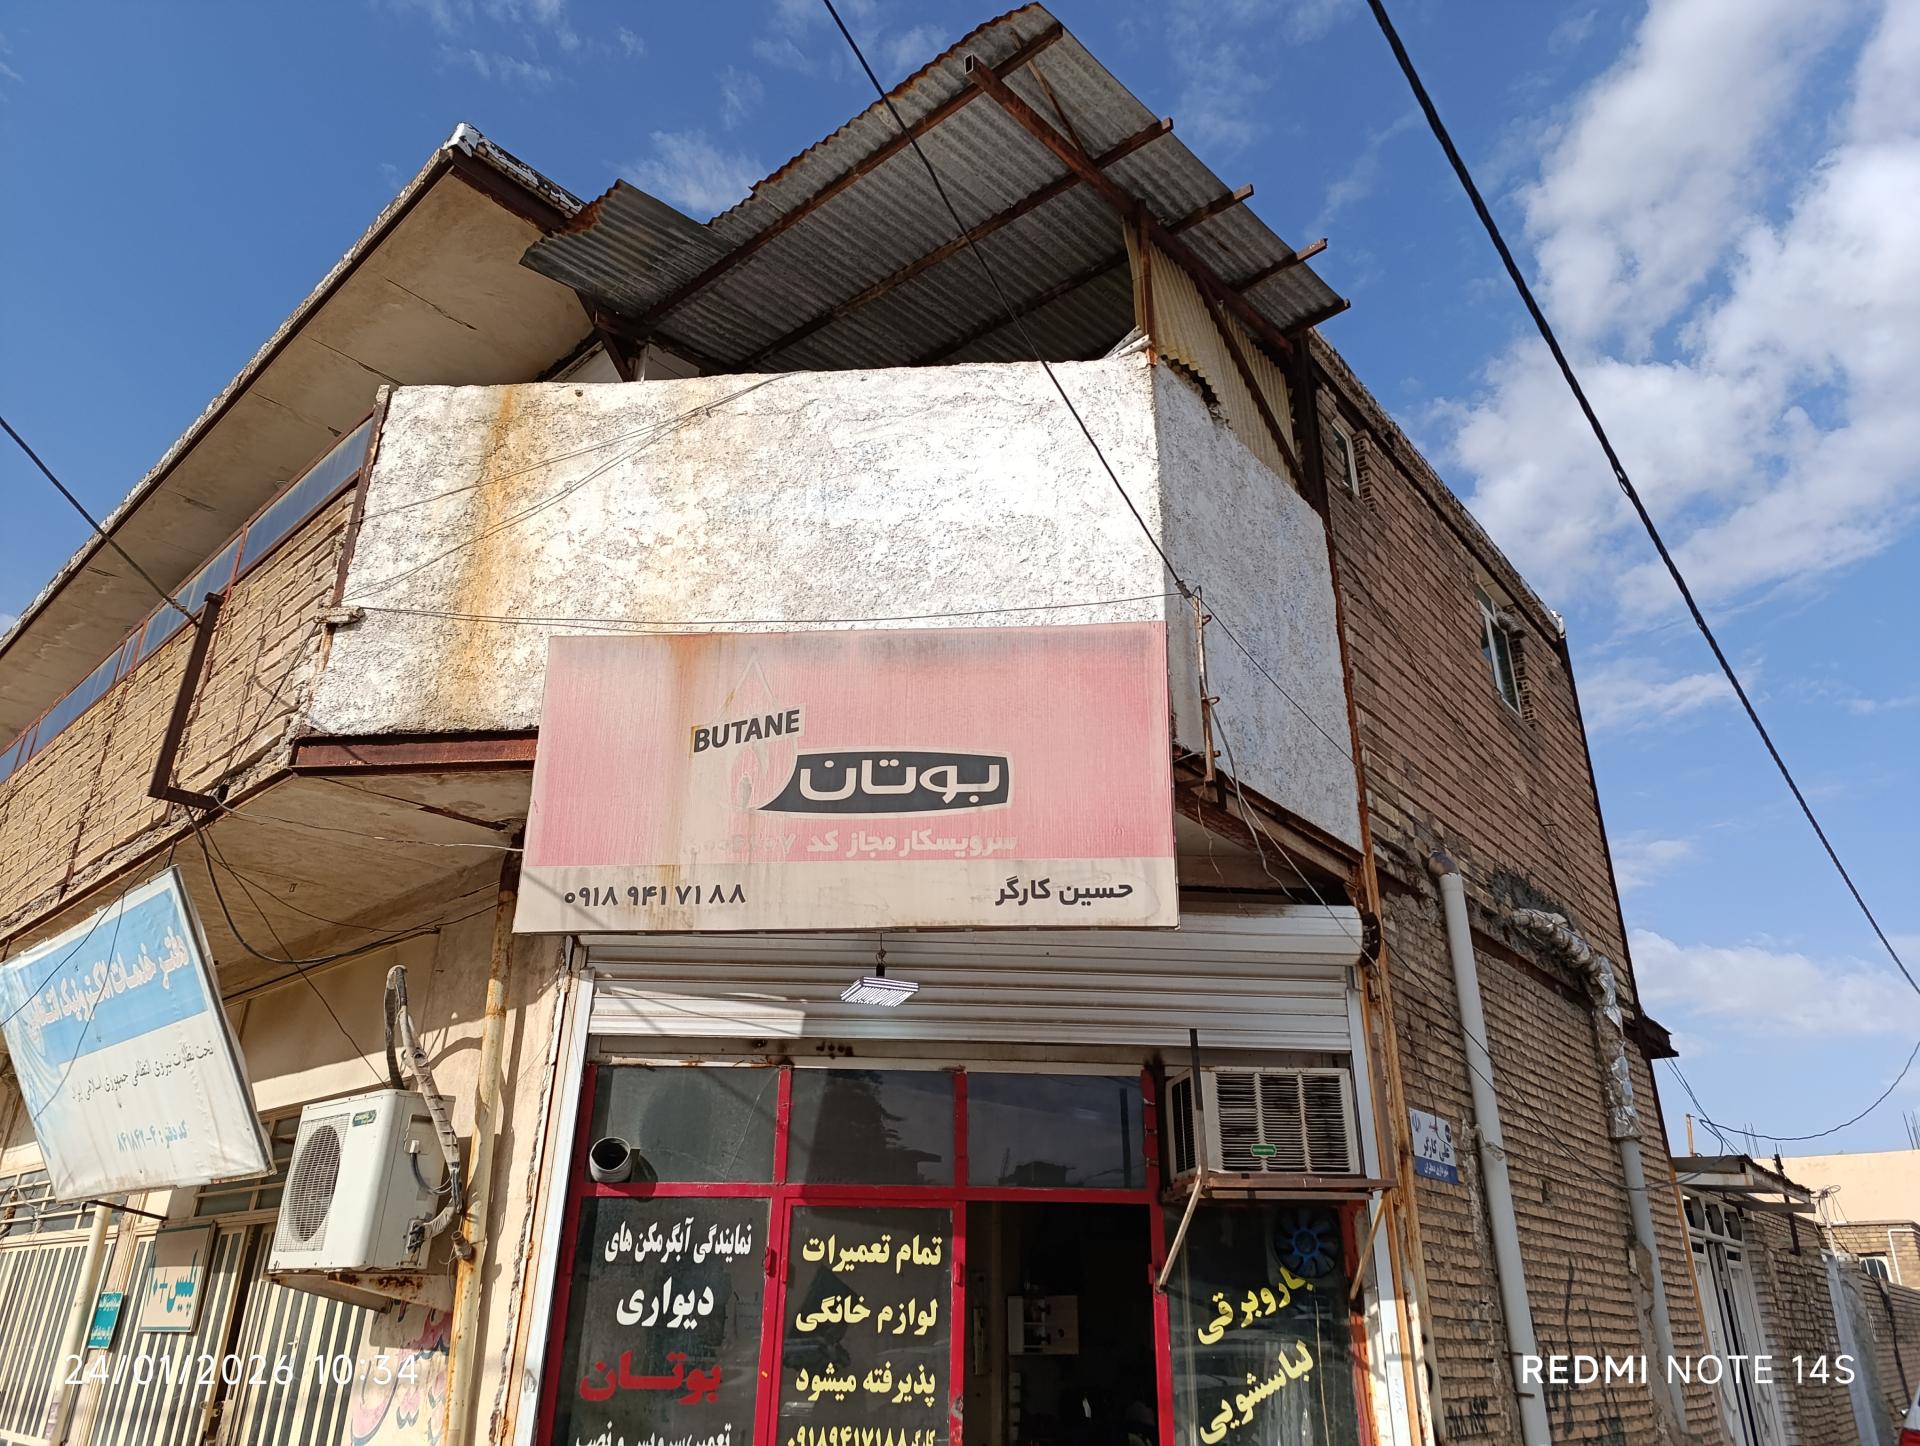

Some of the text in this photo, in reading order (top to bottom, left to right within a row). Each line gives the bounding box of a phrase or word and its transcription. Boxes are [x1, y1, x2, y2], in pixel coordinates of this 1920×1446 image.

[693, 709, 800, 753] BUTANE
[800, 758, 1001, 805] بوتان
[806, 829, 838, 852] کد
[846, 831, 896, 858] مجاز
[899, 829, 1017, 858] سرویسکار
[994, 875, 1134, 906] حسین کارگر
[111, 943, 157, 994] خدمات
[159, 926, 190, 989] دفتر
[195, 1040, 214, 1060] تحت
[604, 1220, 633, 1263] های
[693, 1223, 752, 1264] نمایندگی
[802, 1234, 943, 1275] تمام تعمیرات
[616, 1276, 714, 1330] دیواری
[795, 1295, 939, 1336] لوازم خانگی
[579, 1351, 722, 1405] بوتان
[795, 1360, 936, 1408] پذیرفته میشود
[1200, 1339, 1314, 1445] لباسشویی
